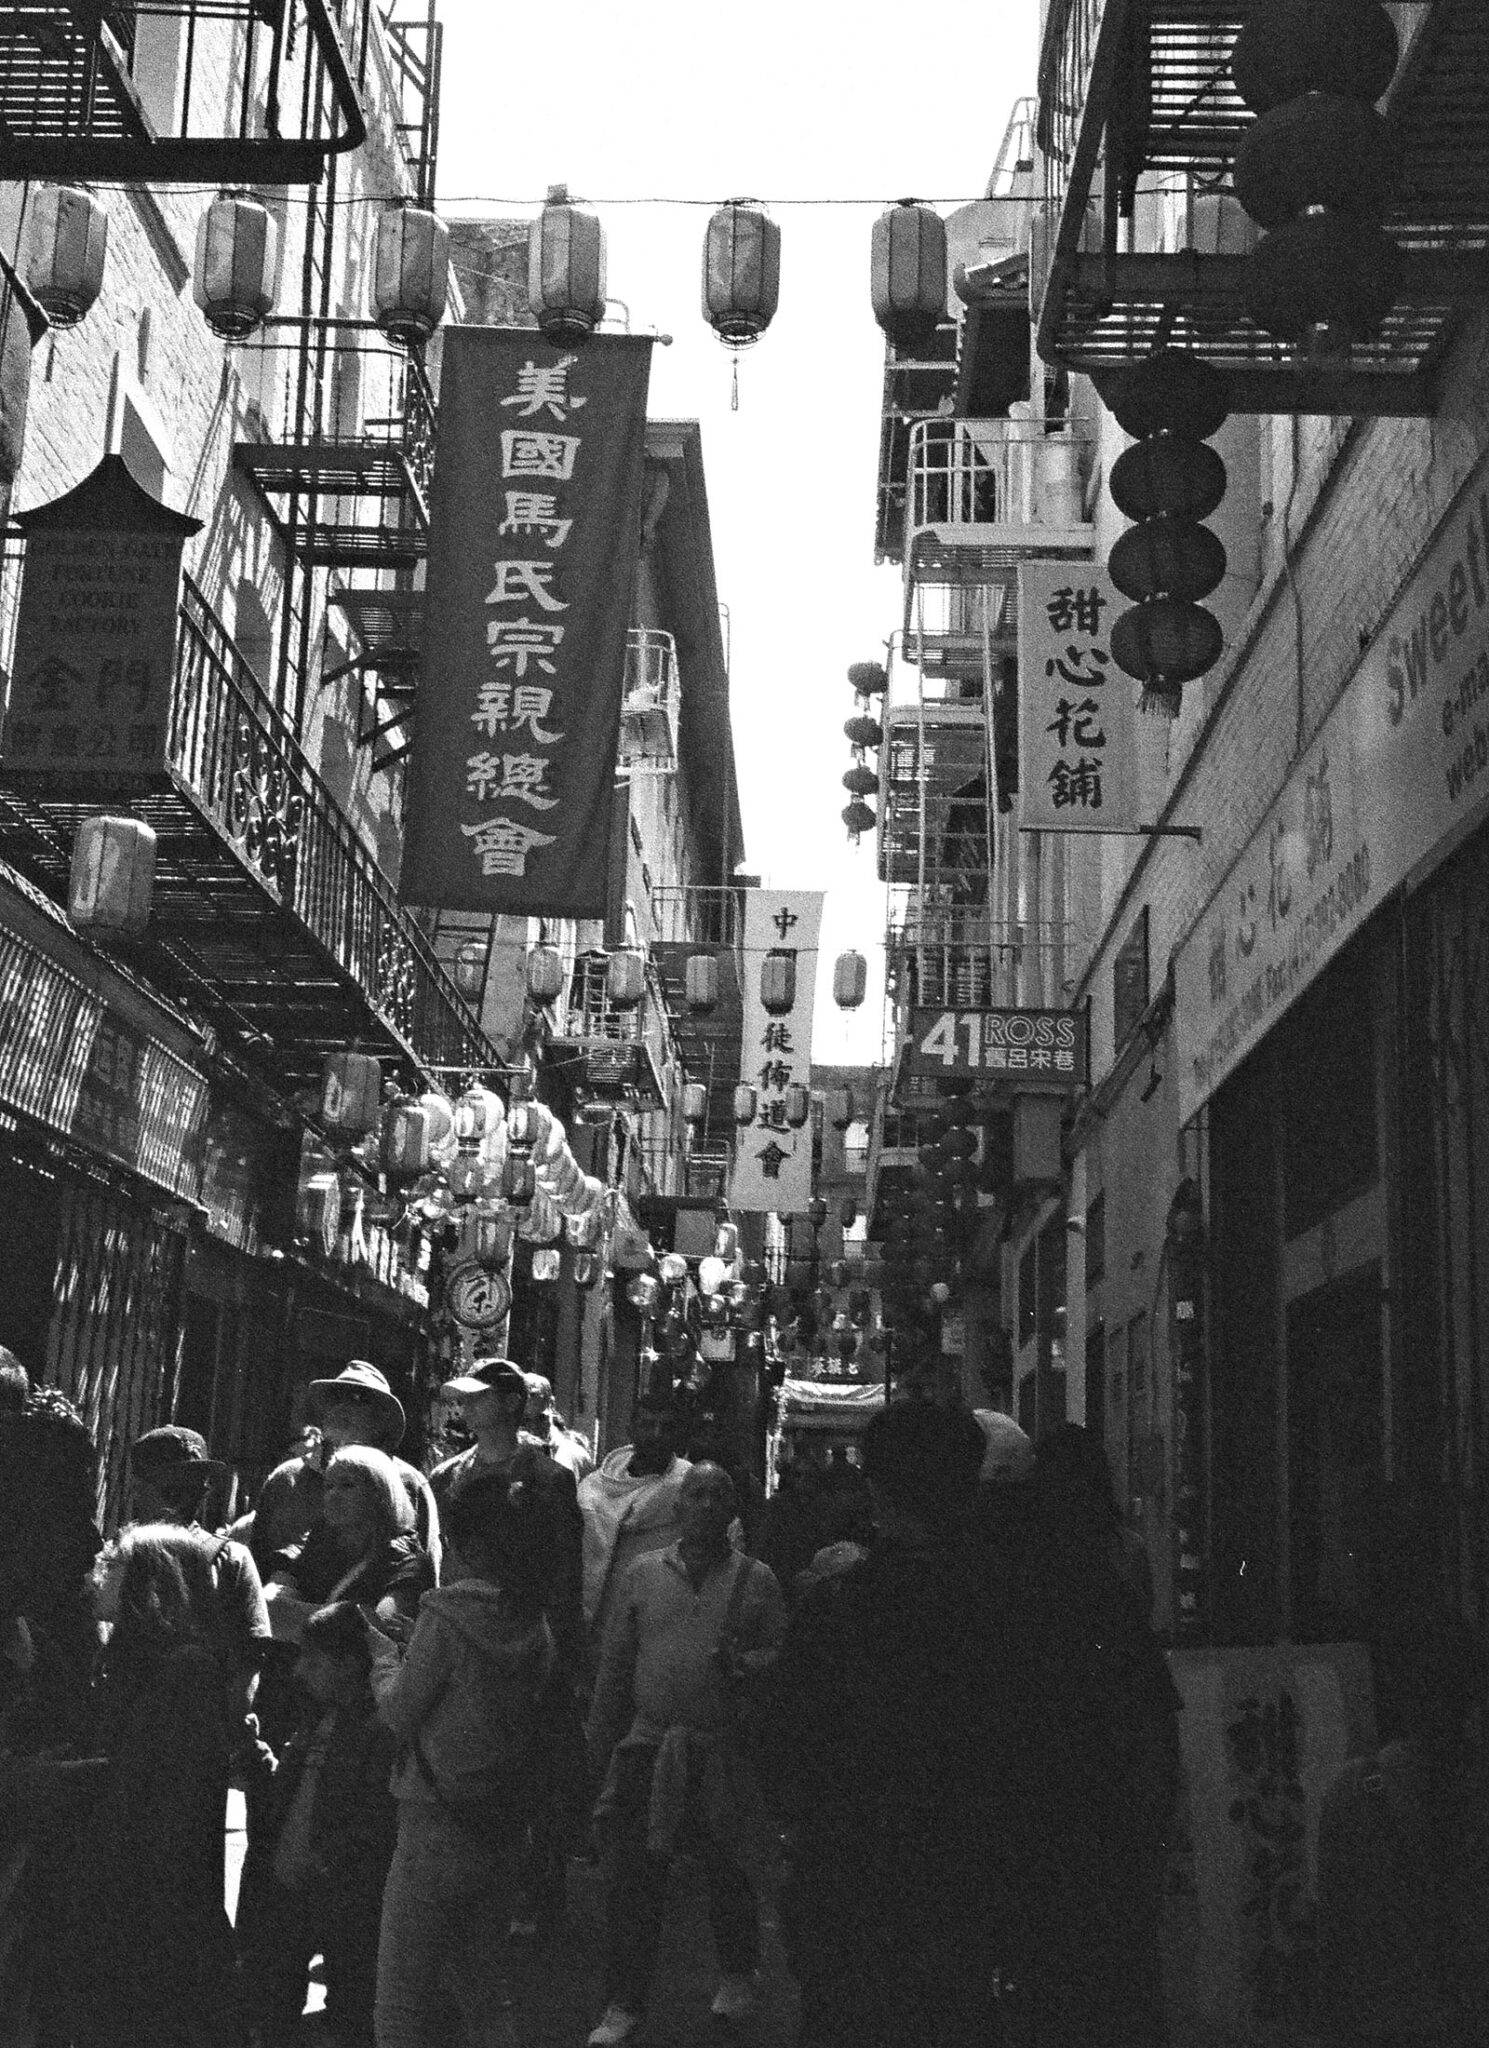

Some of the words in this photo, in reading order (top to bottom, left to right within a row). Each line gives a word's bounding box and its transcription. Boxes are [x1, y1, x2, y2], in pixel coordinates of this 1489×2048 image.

[49, 615, 140, 635] FACTORY
[57, 590, 139, 610] COOKIE
[460, 354, 588, 878] 美國馬氏宗親總會
[27, 656, 151, 713] 金門
[1045, 586, 1110, 810] 甜心花舖
[755, 906, 797, 1180] 中徒佈道會
[920, 1012, 979, 1067] 41
[984, 1014, 1075, 1047] ROSS
